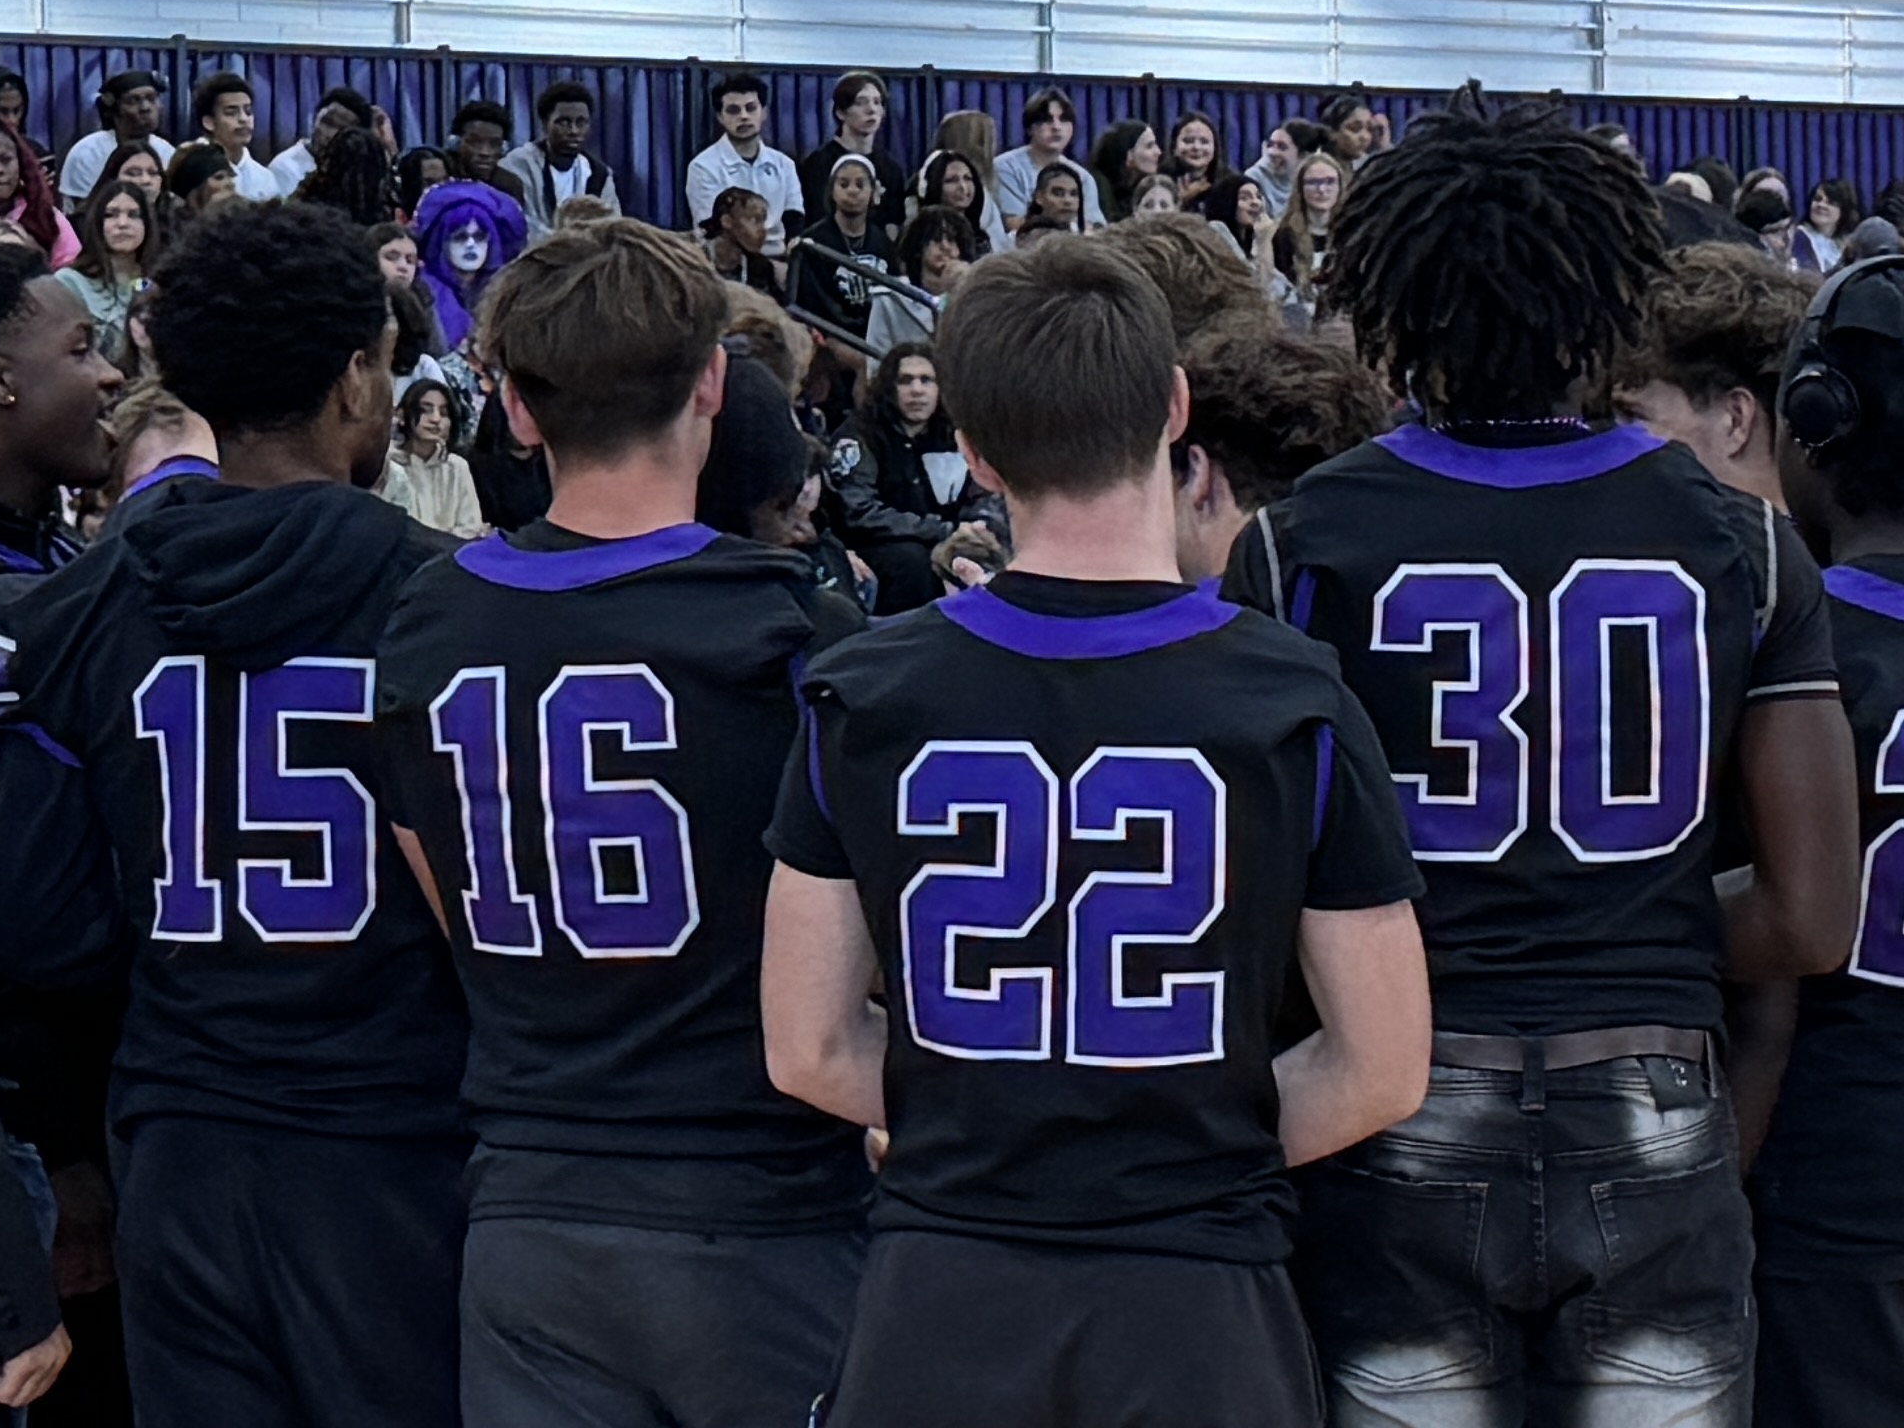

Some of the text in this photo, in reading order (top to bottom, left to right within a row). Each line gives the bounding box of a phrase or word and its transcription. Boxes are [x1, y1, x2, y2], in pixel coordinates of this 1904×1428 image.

[133, 654, 376, 942] 15
[429, 662, 701, 959] 16
[1370, 559, 1710, 862] 30
[897, 739, 1227, 1066] 22
